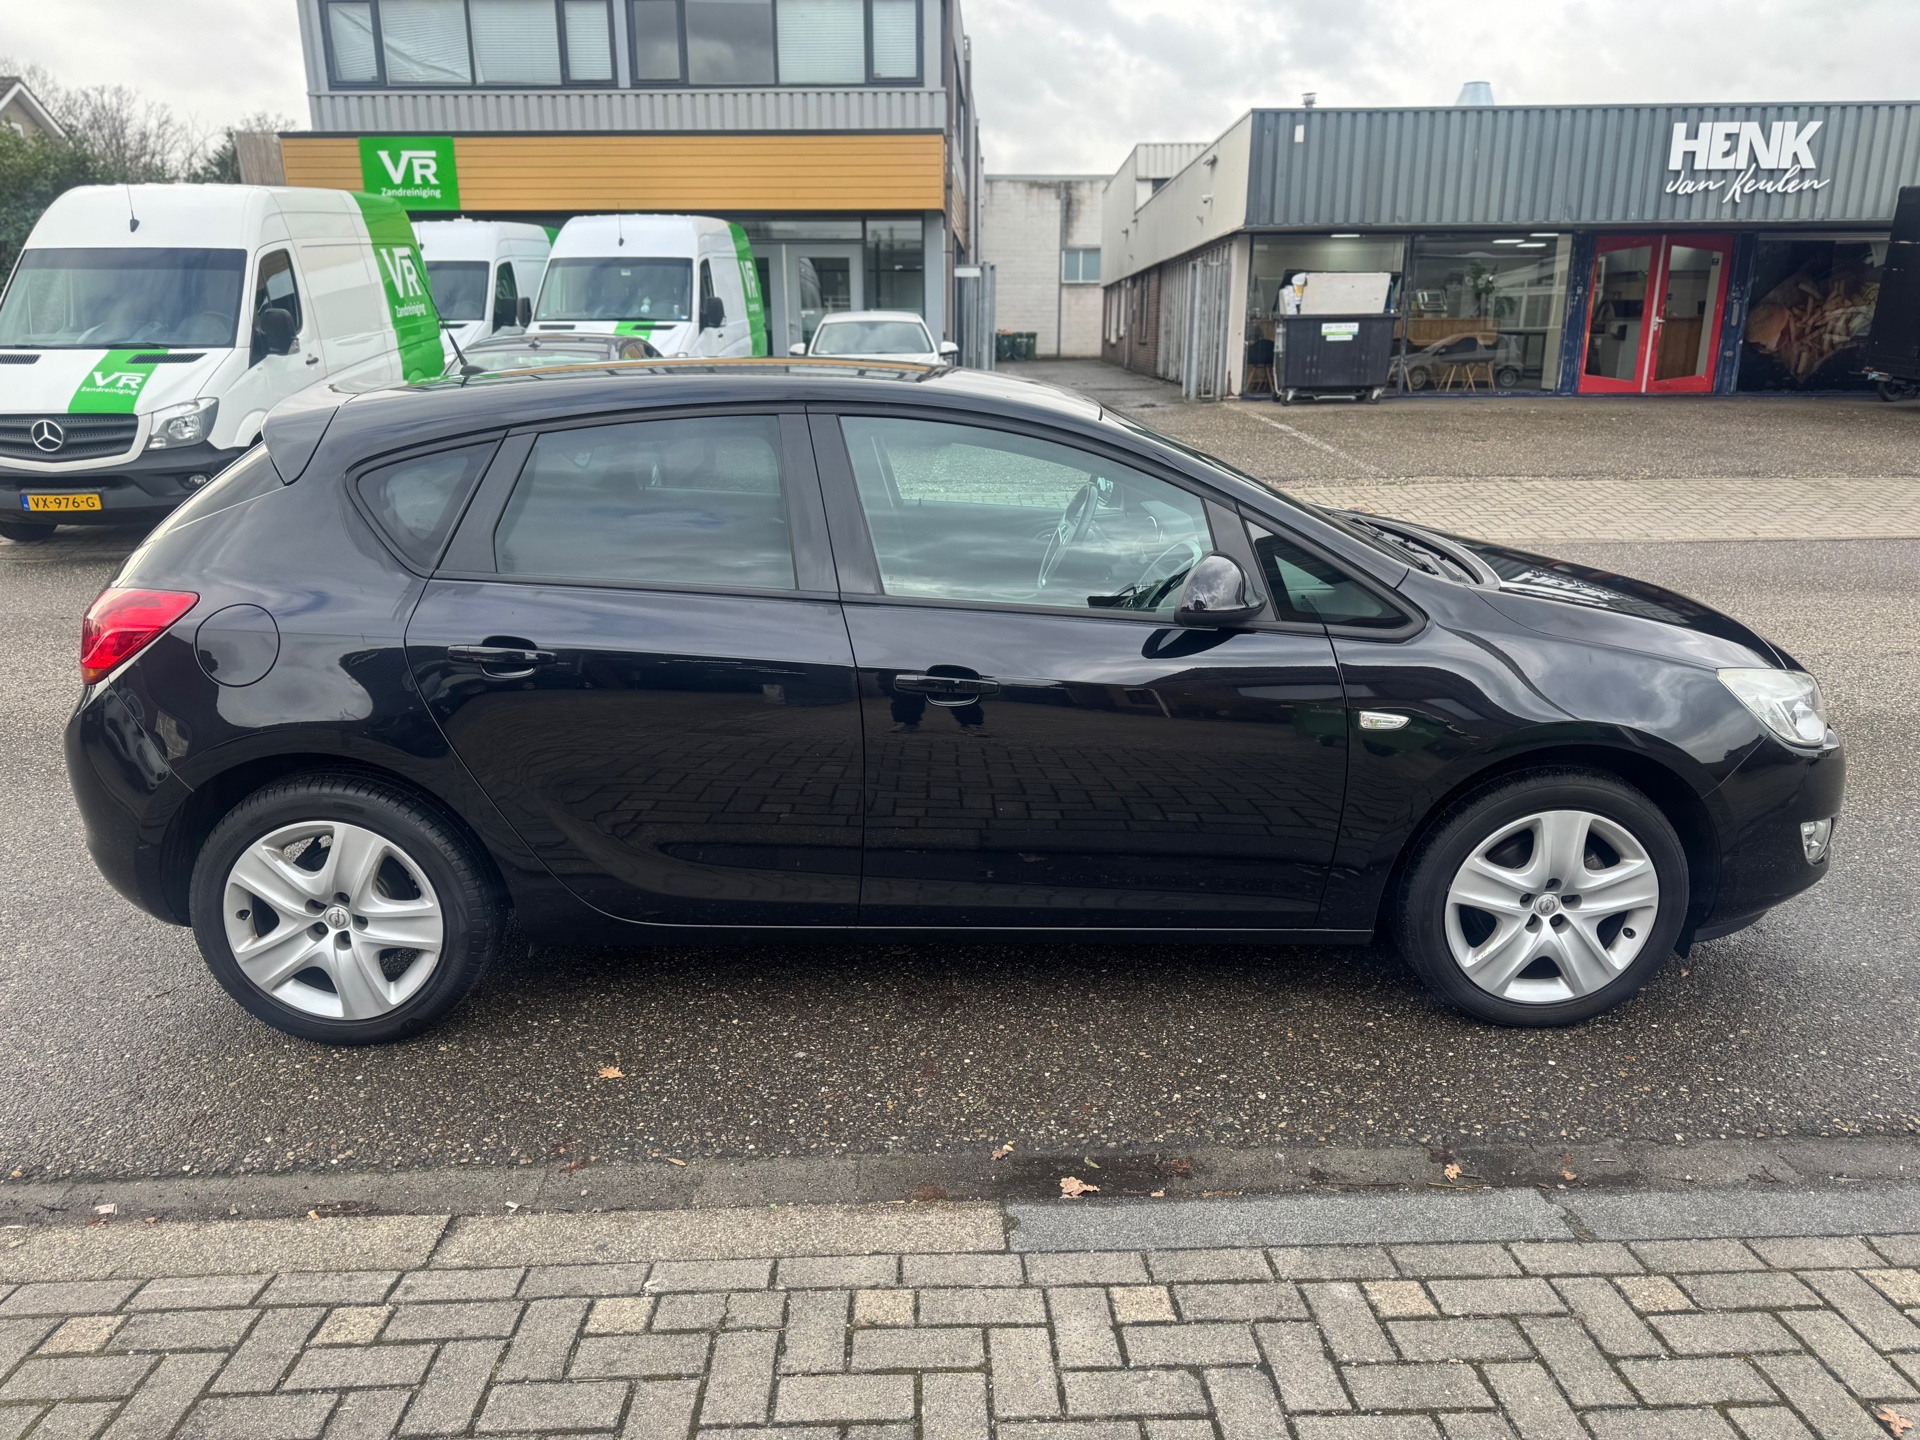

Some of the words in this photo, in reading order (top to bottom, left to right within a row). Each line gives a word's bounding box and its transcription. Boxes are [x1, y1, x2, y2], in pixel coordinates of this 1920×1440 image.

[1668, 121, 1823, 170] HENK
[377, 150, 440, 185] VR
[1722, 163, 1830, 204] Keulen
[381, 187, 441, 199] Zandreiniging
[379, 247, 422, 298] VR
[395, 301, 426, 318] Zandreiniging
[93, 371, 146, 389] VR
[81, 386, 138, 395] Zandreiniging
[31, 496, 96, 509] VX-976-G
